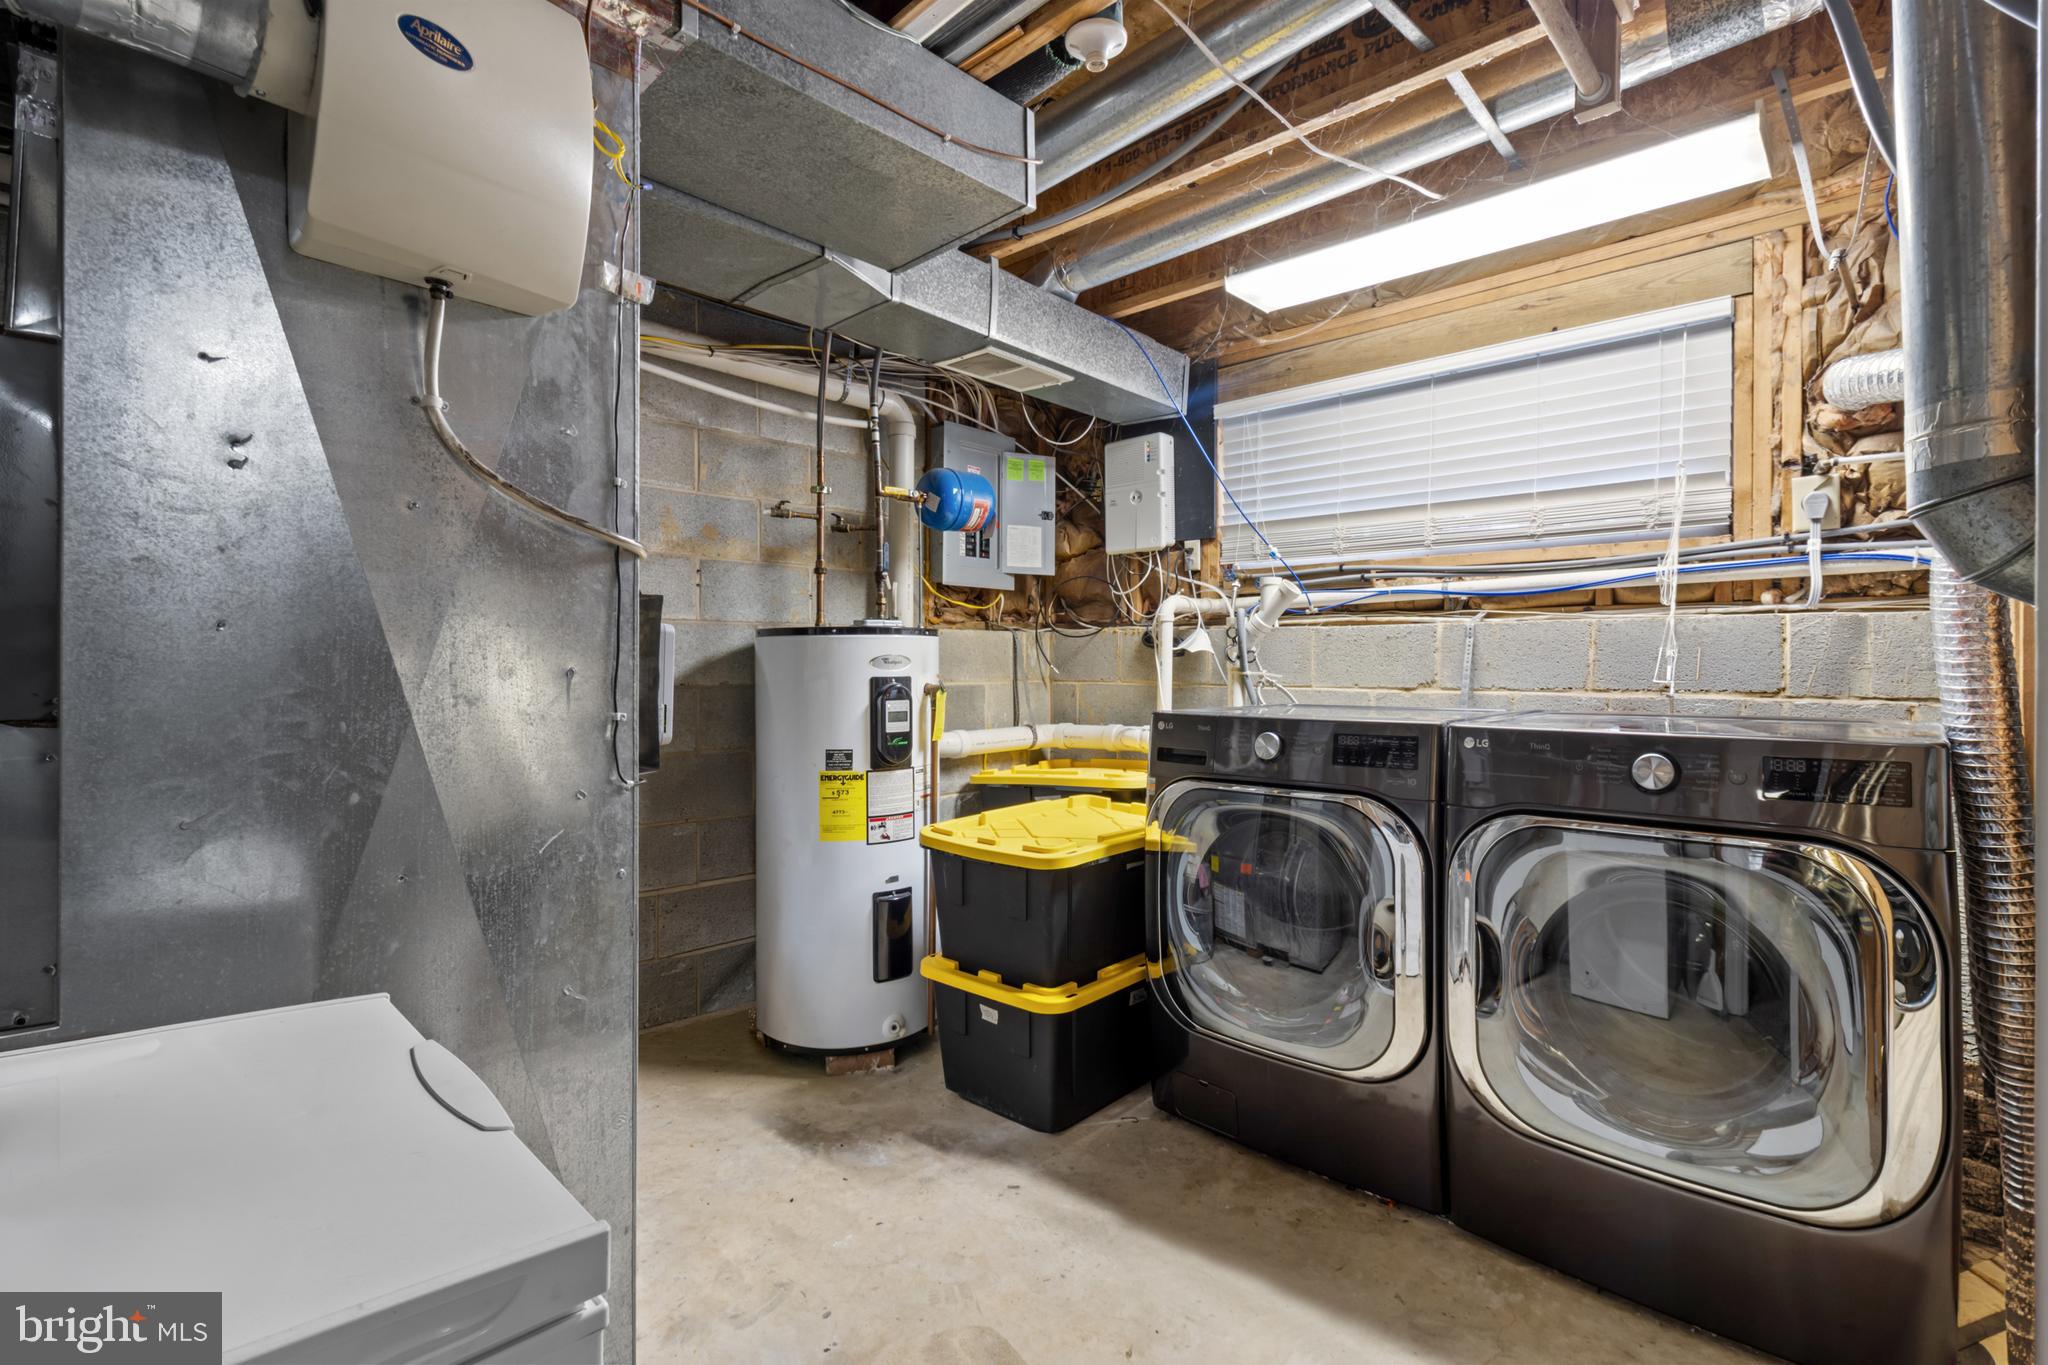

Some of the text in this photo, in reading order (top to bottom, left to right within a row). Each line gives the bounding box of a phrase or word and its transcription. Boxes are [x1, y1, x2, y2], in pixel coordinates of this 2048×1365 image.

[410, 18, 462, 55] Aprilaire
[1165, 720, 1174, 729] LG
[1475, 738, 1489, 748] LG
[1529, 742, 1551, 750] ThinQ
